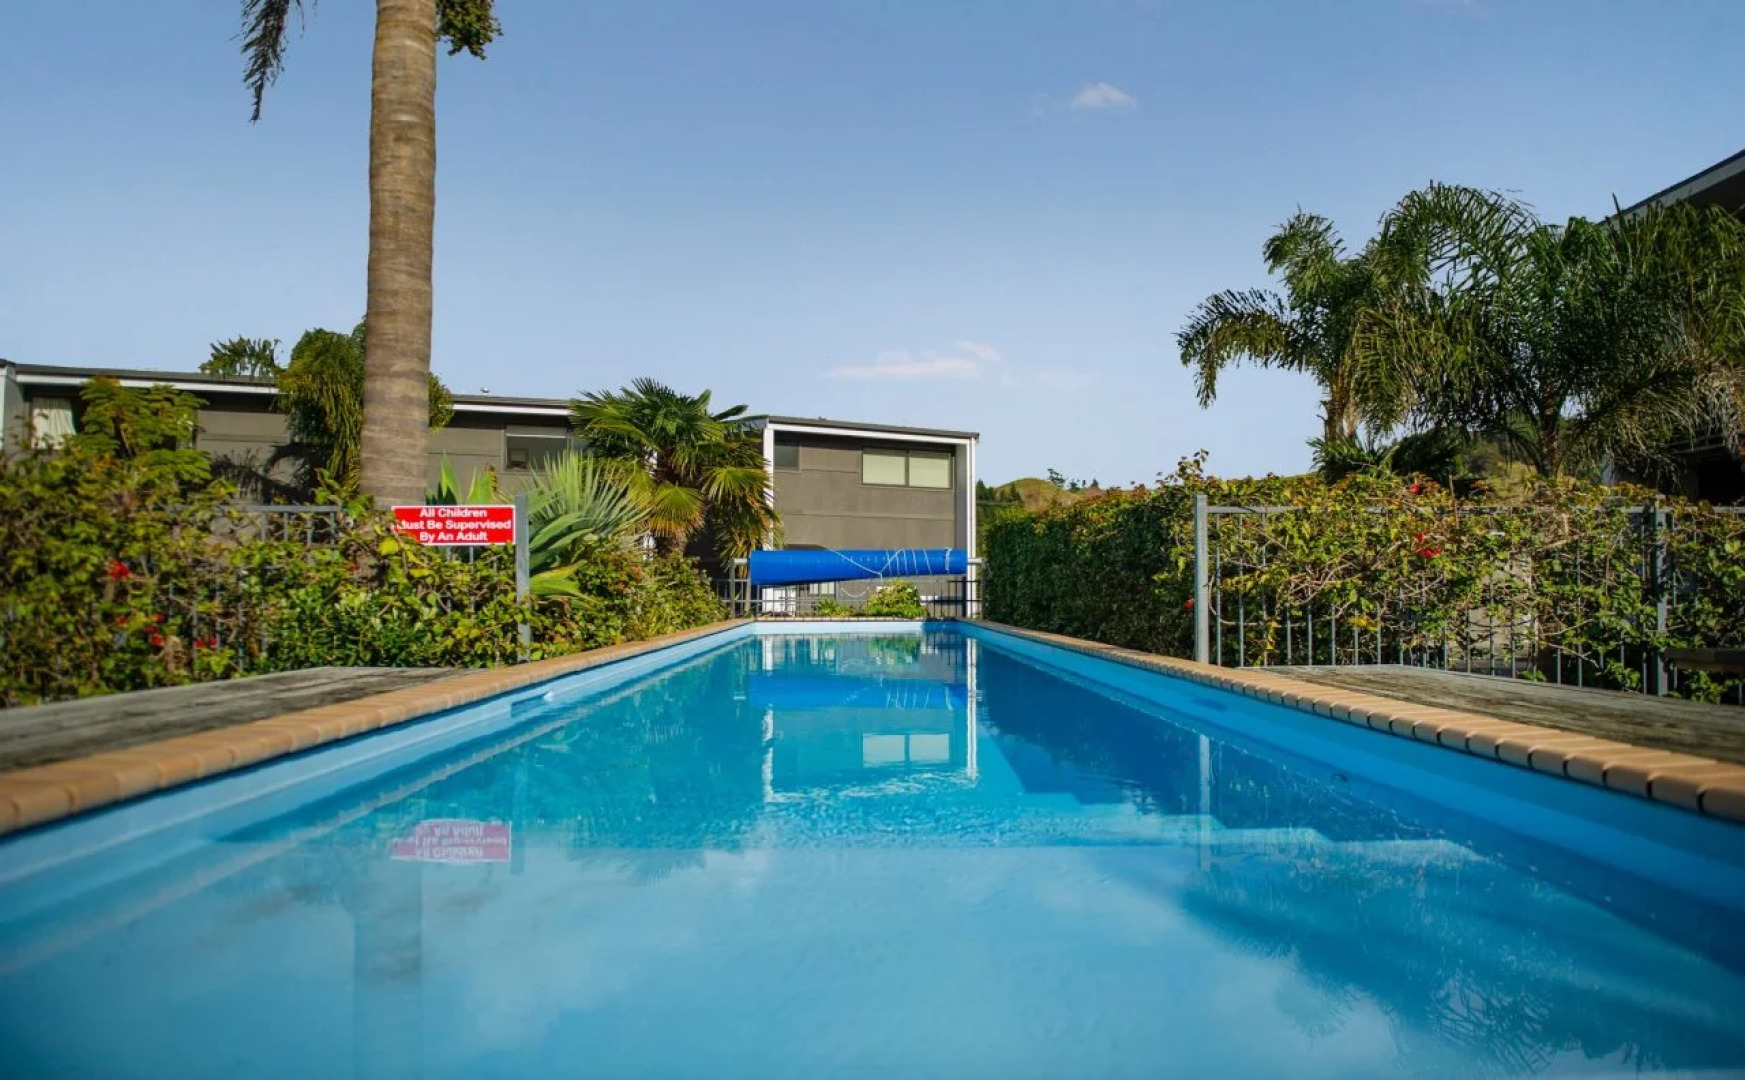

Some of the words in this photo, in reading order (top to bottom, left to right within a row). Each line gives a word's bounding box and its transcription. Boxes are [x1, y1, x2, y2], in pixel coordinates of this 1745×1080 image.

[420, 508, 435, 517] All
[438, 508, 487, 517] Children
[427, 520, 443, 529] Be
[445, 520, 512, 531] Supervised
[420, 532, 435, 544] By
[437, 532, 454, 541] An
[456, 532, 488, 541] Adult
